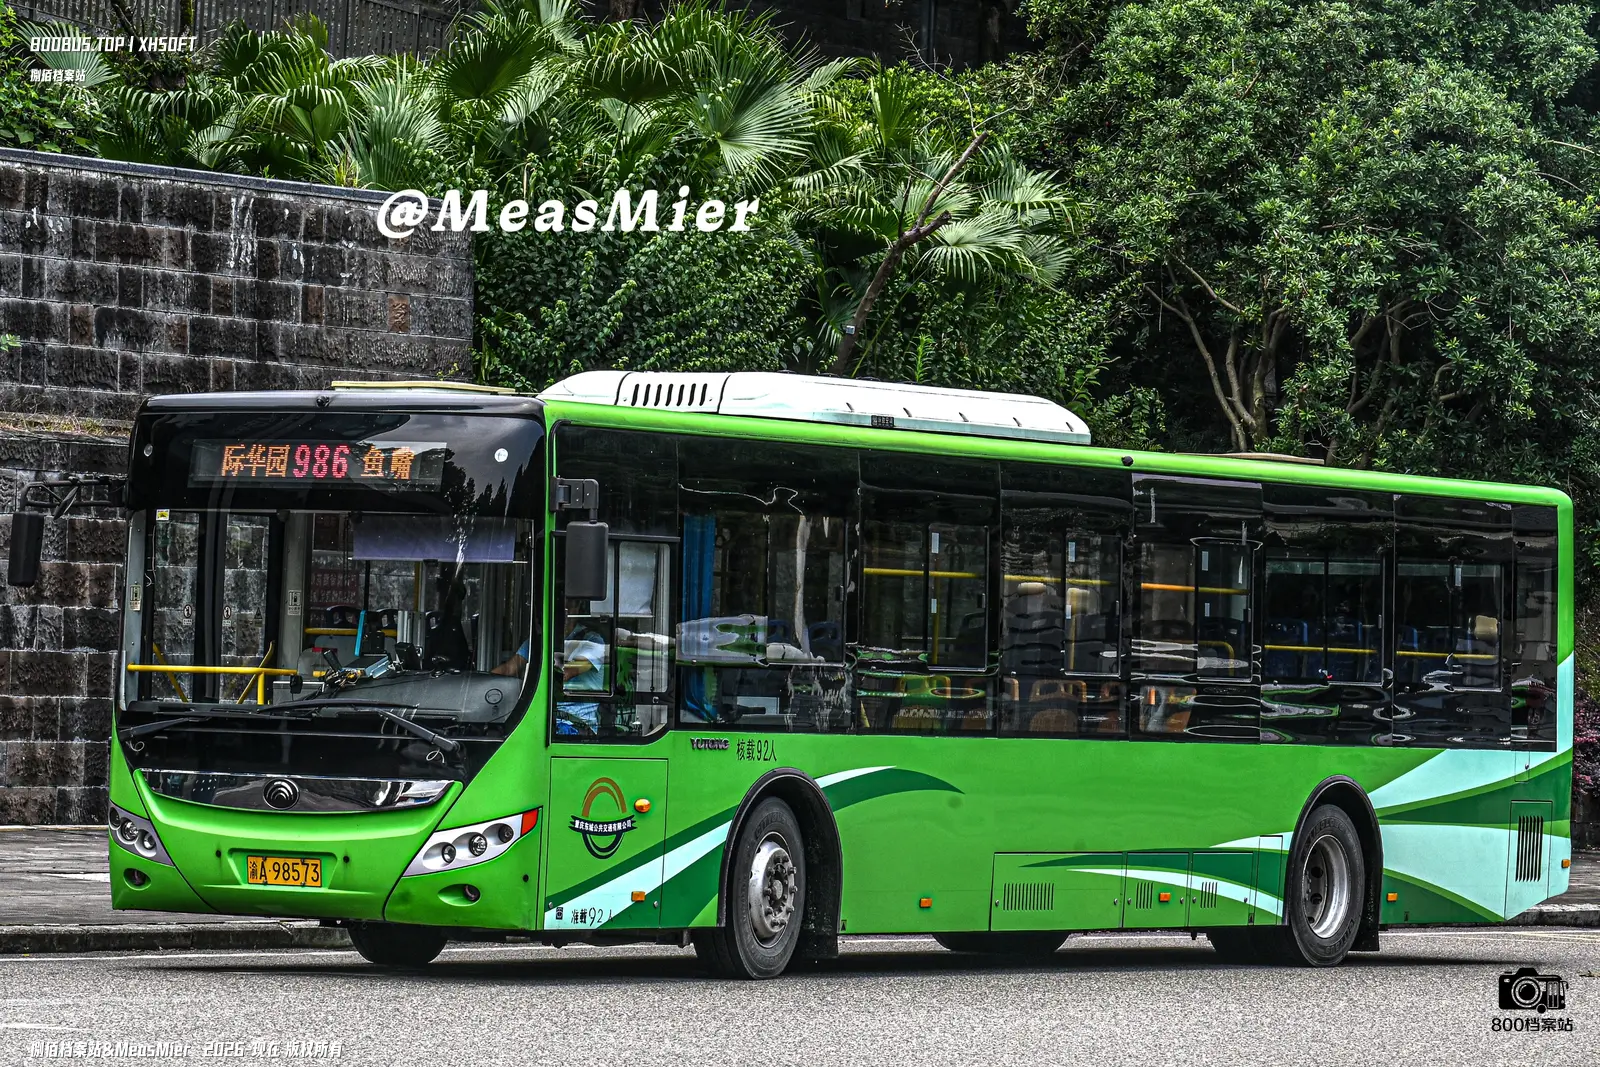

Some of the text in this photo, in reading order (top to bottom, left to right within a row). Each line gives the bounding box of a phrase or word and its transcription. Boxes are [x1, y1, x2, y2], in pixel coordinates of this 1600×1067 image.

[221, 444, 415, 479] 际华园 986 鱼嘴
[690, 737, 730, 750] YUTONG
[736, 739, 777, 761] 核载92人
